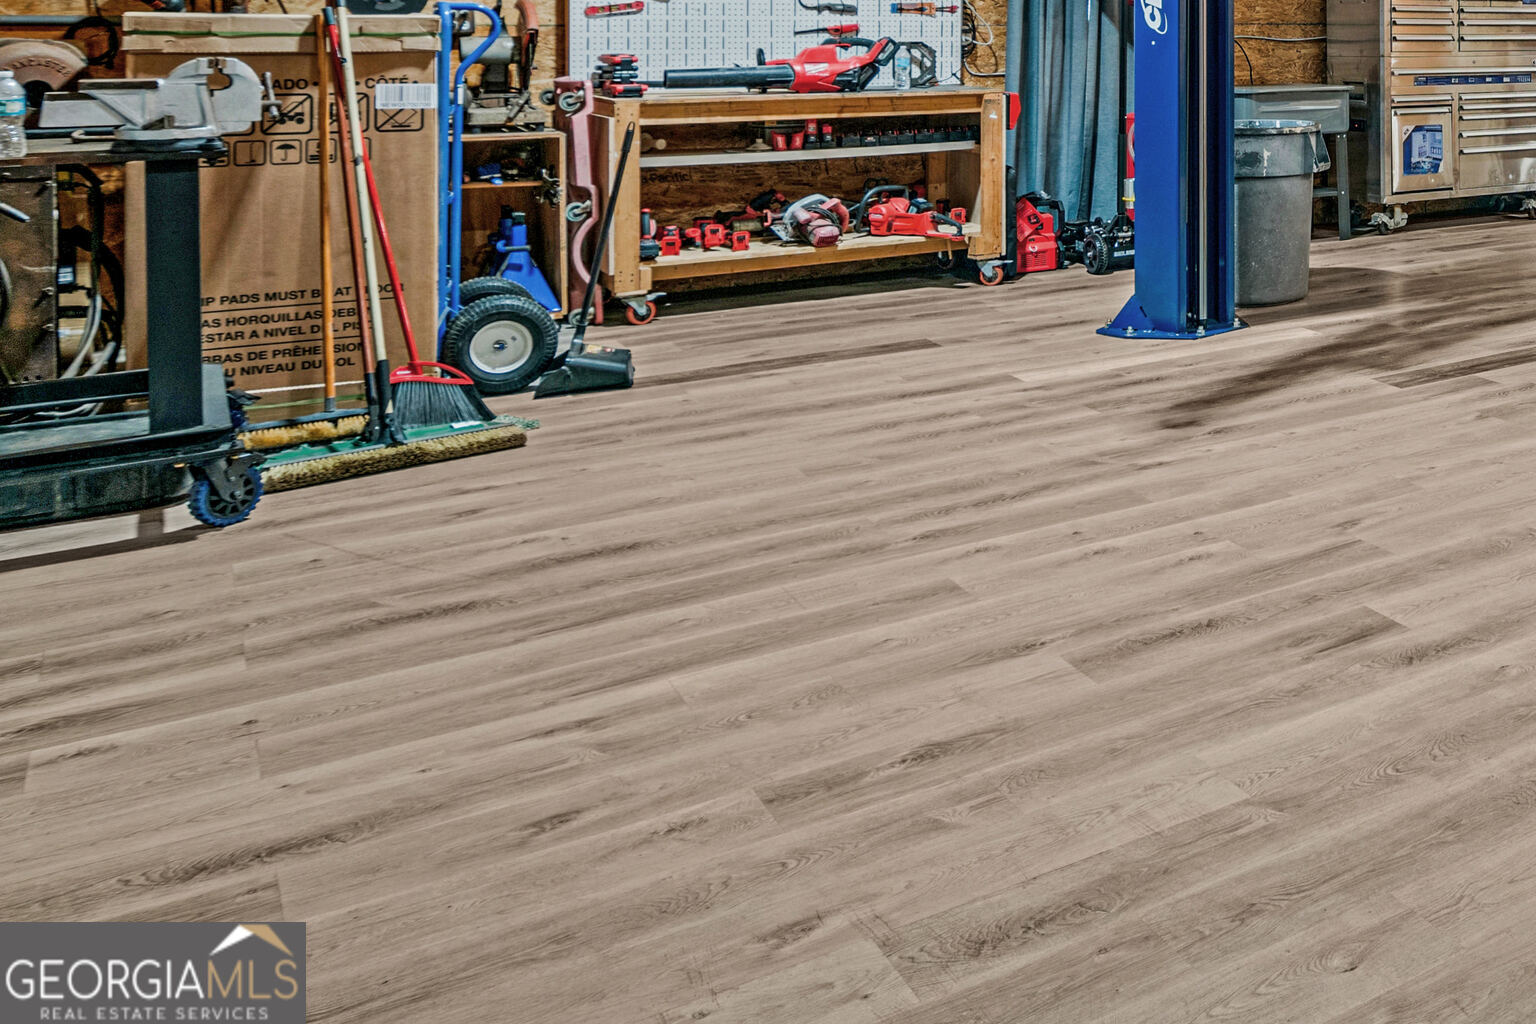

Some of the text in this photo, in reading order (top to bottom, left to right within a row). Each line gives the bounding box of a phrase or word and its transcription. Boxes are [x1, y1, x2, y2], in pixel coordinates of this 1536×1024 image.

[273, 78, 309, 91] ADO
[201, 296, 215, 307] IP
[219, 291, 261, 306] PADS
[264, 289, 307, 302] MUST
[334, 286, 352, 297] AT
[202, 317, 221, 329] AS
[225, 309, 323, 327] HORQUILLAS
[249, 329, 261, 340] A
[264, 324, 307, 338] NIVEL
[247, 348, 268, 361] DE
[240, 358, 296, 377] NIVEAU
[301, 359, 323, 371] DU
[334, 356, 356, 367] OL
